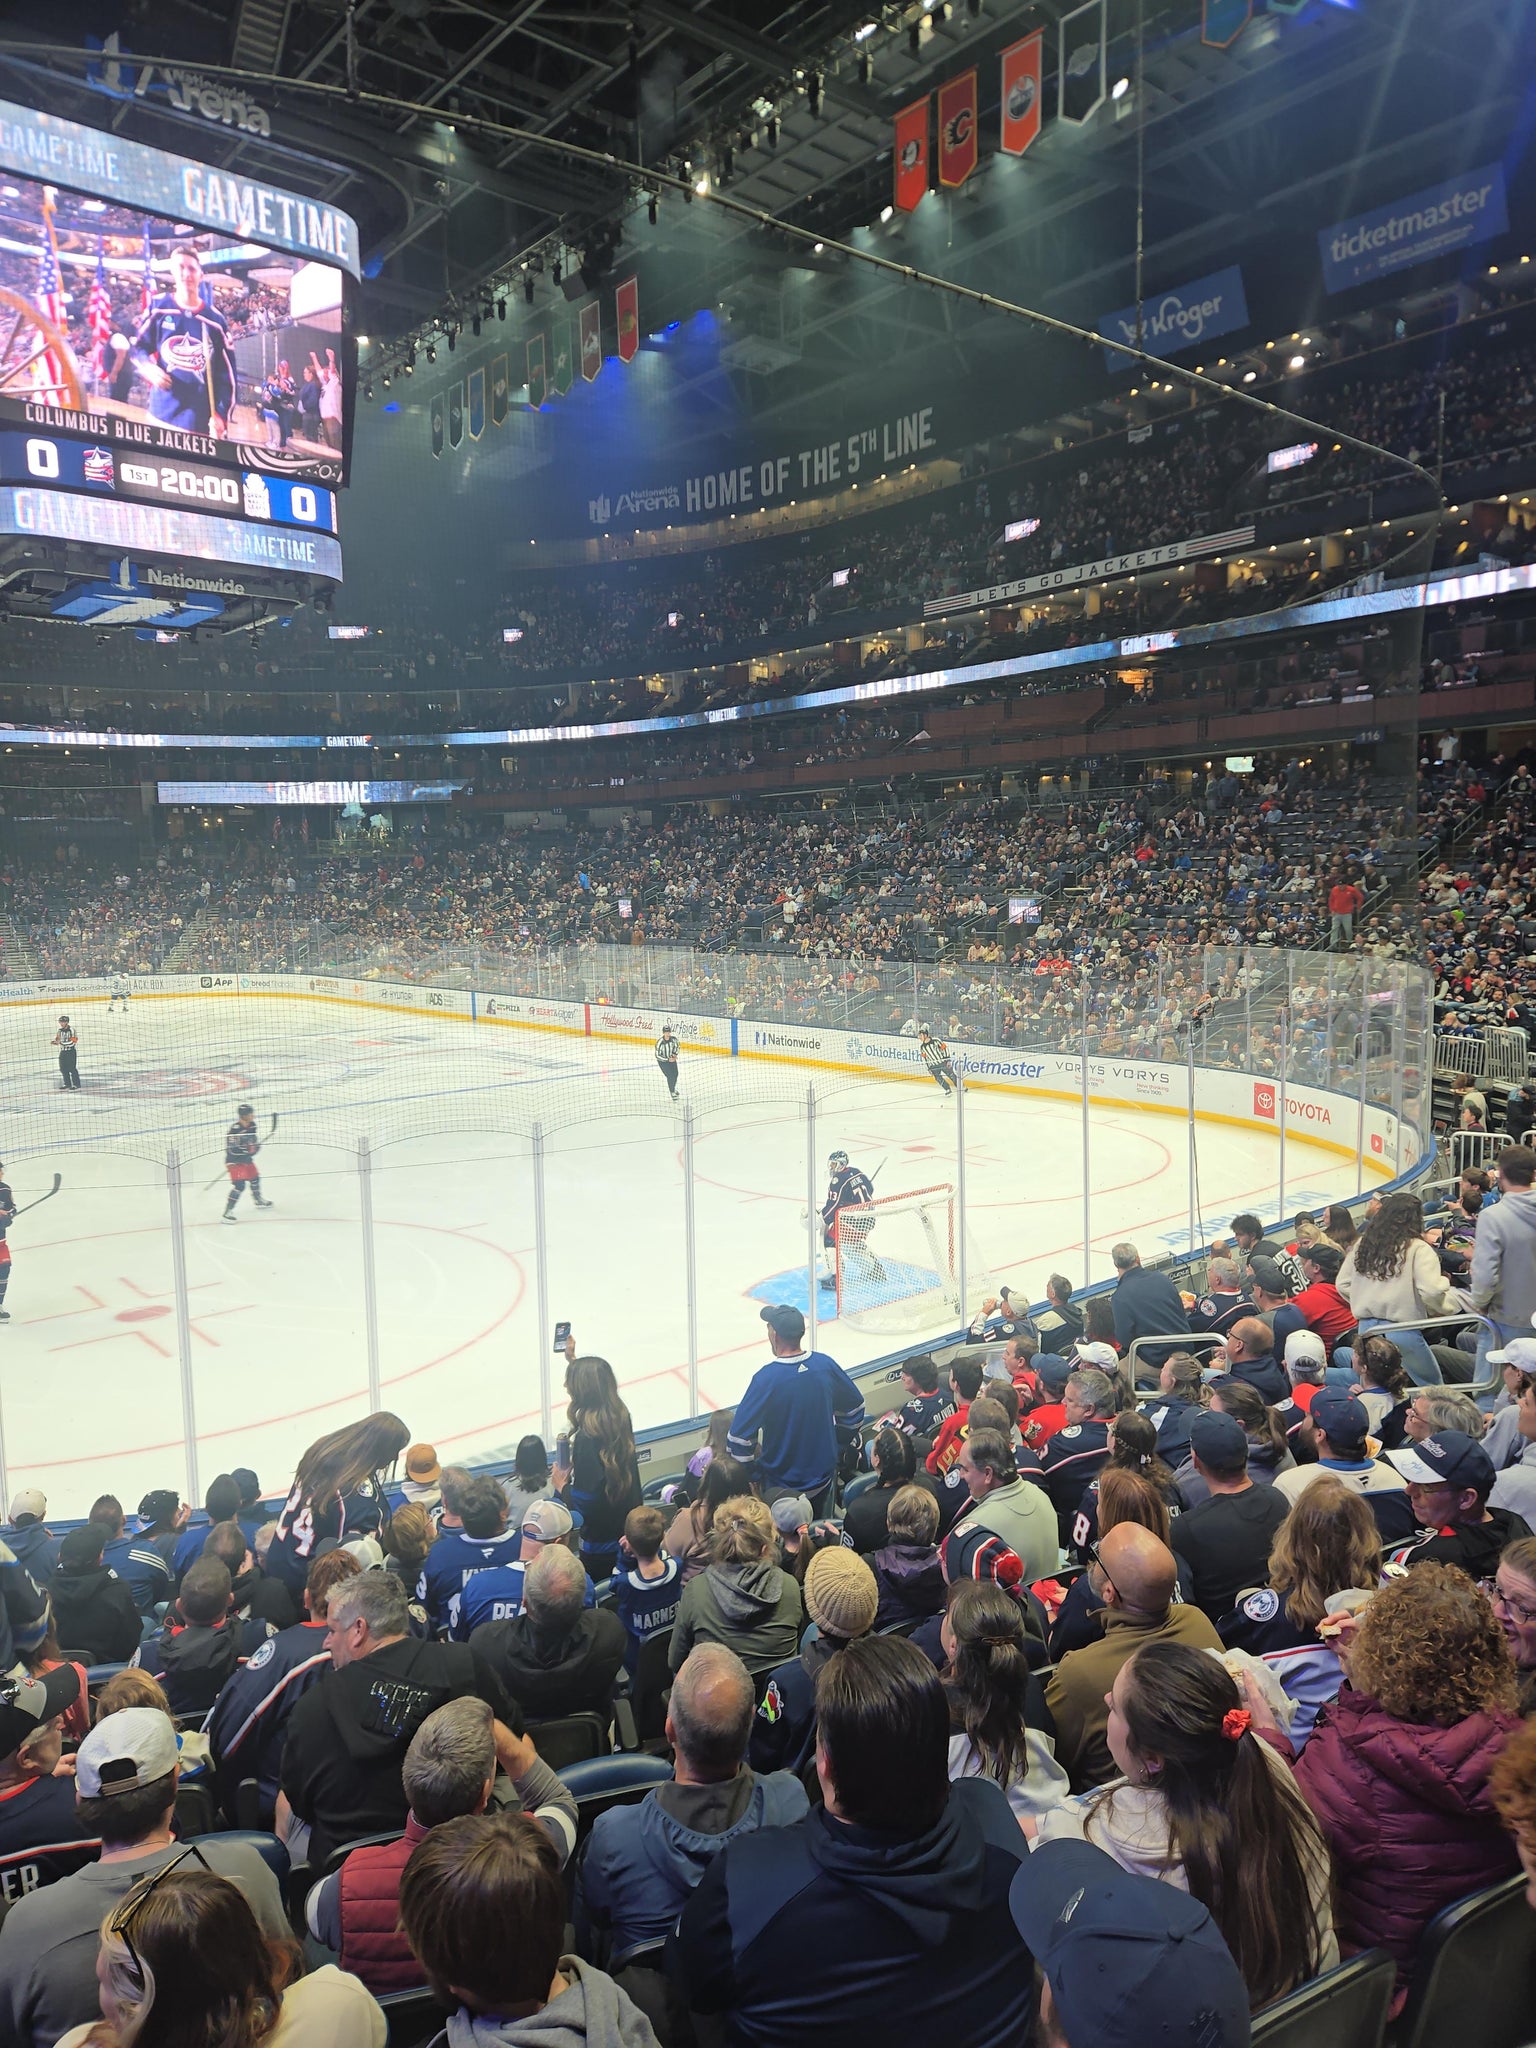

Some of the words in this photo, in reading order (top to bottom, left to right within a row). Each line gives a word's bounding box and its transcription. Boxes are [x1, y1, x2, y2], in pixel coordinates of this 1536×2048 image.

[181, 166, 350, 263] GAMETIME
[1330, 184, 1492, 263] ticketmaster
[1152, 296, 1223, 339] Kroger
[25, 404, 109, 437] COLUMBUS
[115, 421, 152, 445] BLUE
[156, 431, 217, 457] JACKETS
[26, 438, 60, 479] 0
[686, 466, 753, 514] HOME
[760, 456, 791, 498] OF
[798, 442, 841, 489] THE
[848, 427, 878, 475] 5TH
[883, 407, 934, 463] LINE
[129, 469, 152, 482] 1ST
[160, 467, 240, 505] 20:00
[290, 486, 317, 522] 0
[615, 494, 681, 517] Arena
[630, 485, 679, 500] Nationwide
[13, 490, 182, 552] GAMETIME
[232, 528, 317, 565] GAMETIME
[147, 566, 246, 596] Nationwide
[976, 581, 1027, 604] LET'S
[1040, 573, 1064, 589] GO
[1074, 546, 1180, 581] JACKETS
[326, 735, 369, 748] GAMETIME
[1360, 730, 1381, 742] 116
[1083, 759, 1098, 769] 115
[274, 781, 371, 804] GAMETIME
[505, 1004, 520, 1013] PIZZA
[601, 1012, 634, 1028] Hollywood
[634, 1015, 653, 1030] Feed
[666, 1017, 698, 1035] Surfside
[768, 1033, 821, 1050] Nationwide
[865, 1044, 922, 1063] OhioHealth
[951, 1051, 1045, 1078] icketmaster
[1056, 1061, 1105, 1076] VORYS
[1112, 1067, 1170, 1084] VORYS
[1279, 1098, 1331, 1126] TOYOTA
